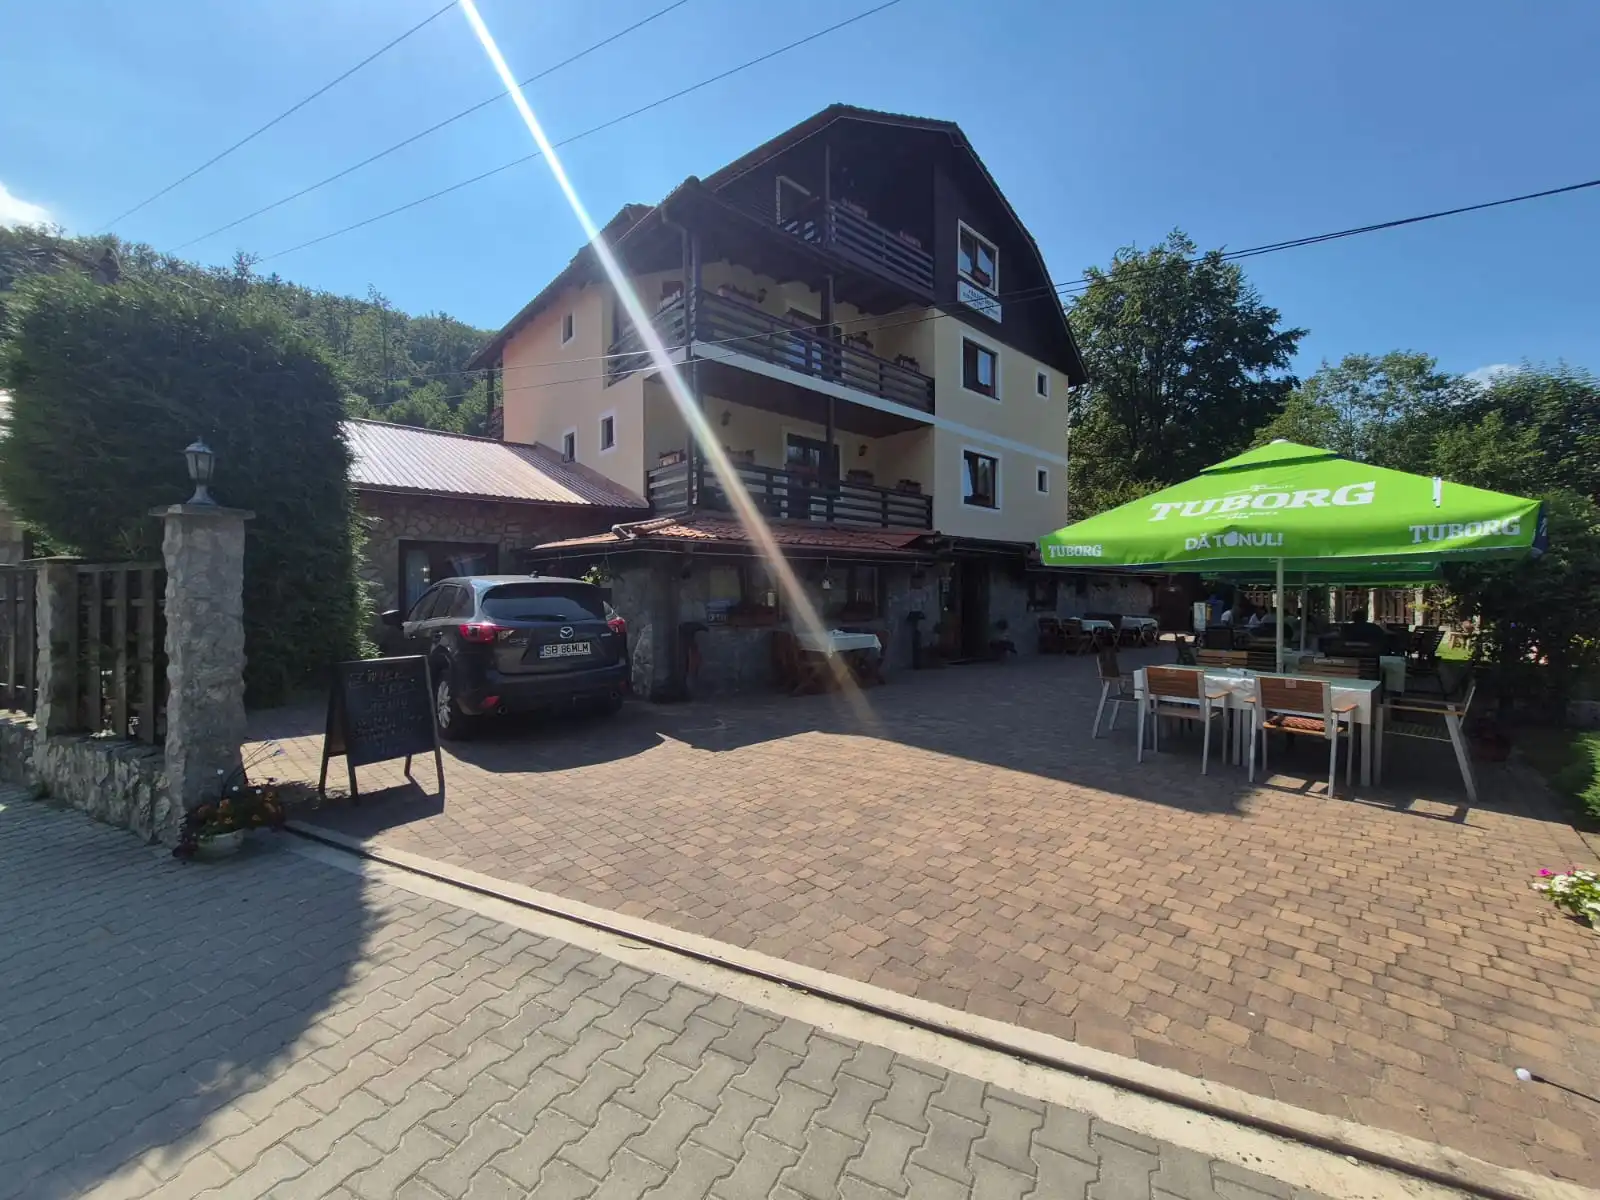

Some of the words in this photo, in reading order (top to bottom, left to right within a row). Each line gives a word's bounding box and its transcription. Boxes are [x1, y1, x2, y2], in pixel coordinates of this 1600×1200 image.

[1148, 481, 1376, 522] TUBORG
[1408, 515, 1521, 544] TUBORG
[1048, 544, 1103, 558] TUBORG
[1185, 532, 1210, 551] DĂ
[545, 645, 558, 655] SB
